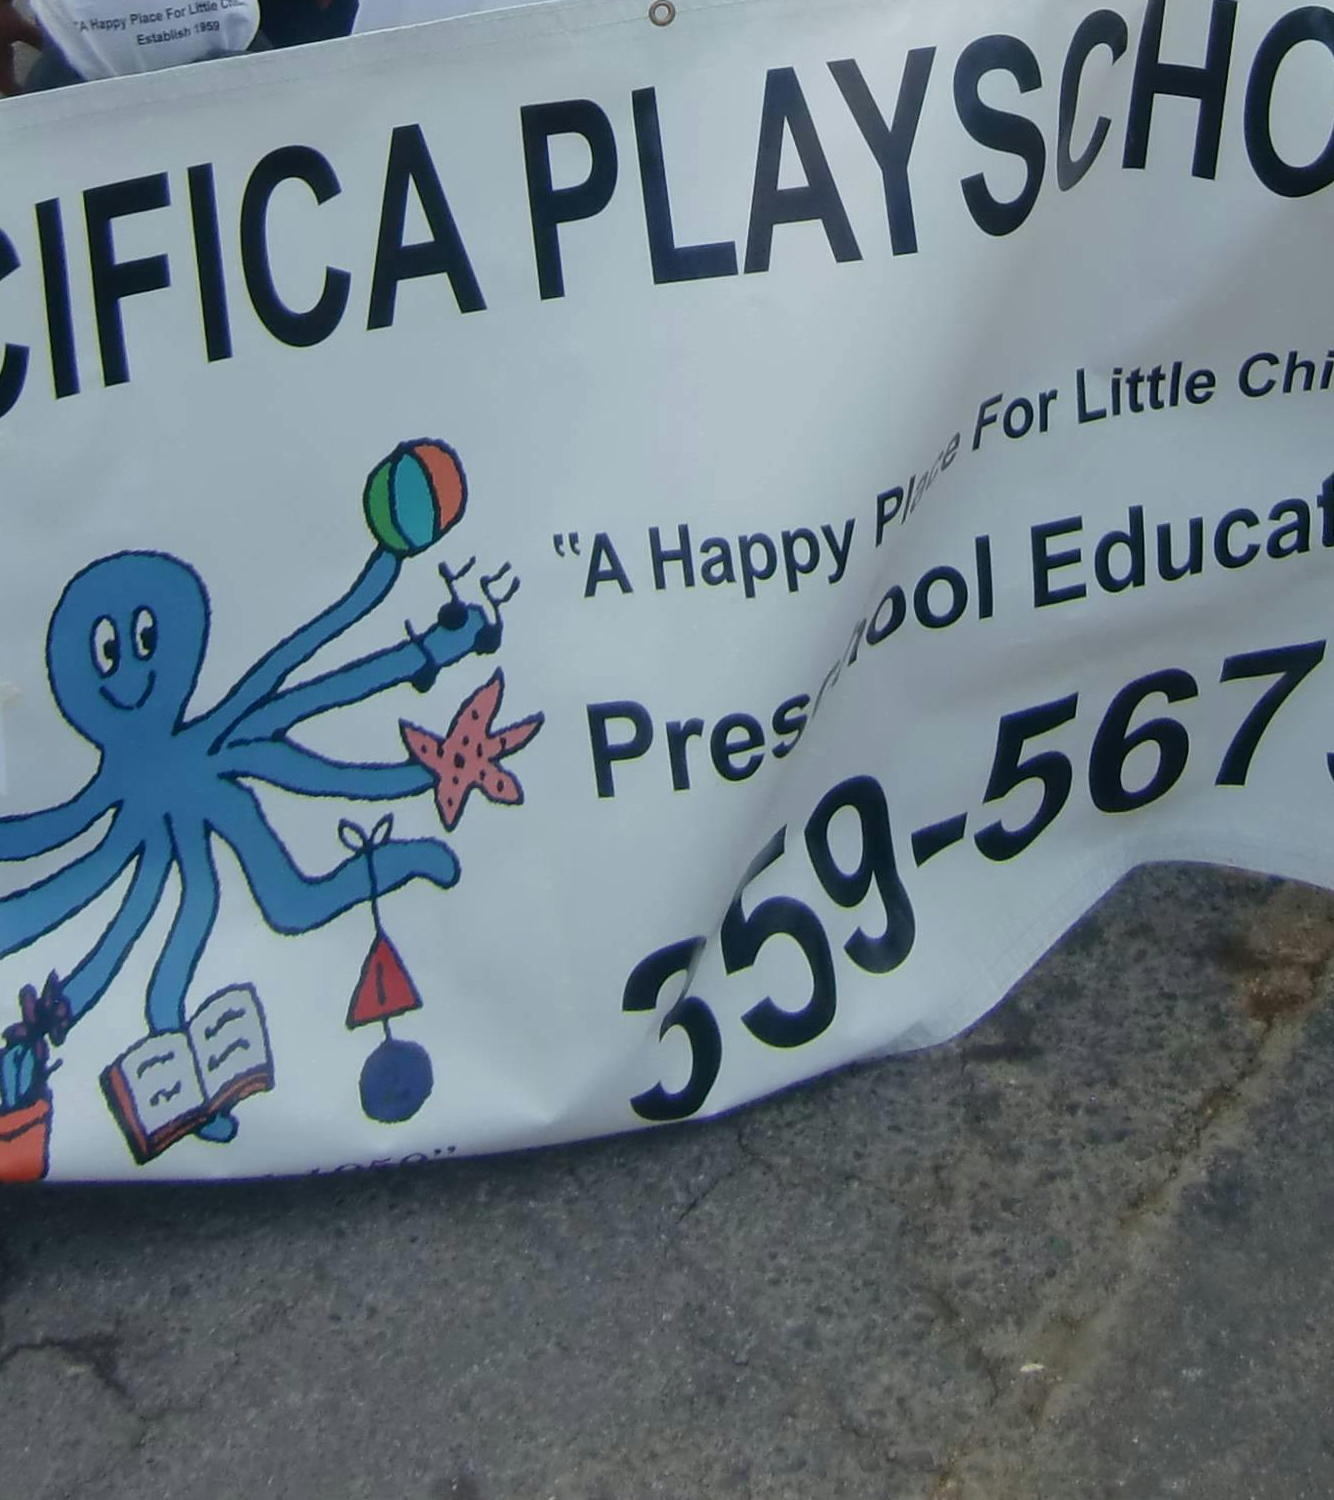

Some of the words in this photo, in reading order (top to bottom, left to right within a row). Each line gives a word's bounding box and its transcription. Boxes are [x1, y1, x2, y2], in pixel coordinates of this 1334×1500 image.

[91, 17, 127, 31] Happy
[130, 11, 163, 25] Place
[166, 7, 186, 20] For
[189, 1, 217, 15] Little
[137, 25, 192, 46] Establish
[648, 518, 856, 599] Happy
[972, 389, 1058, 451] For
[1076, 361, 1217, 424] Little
